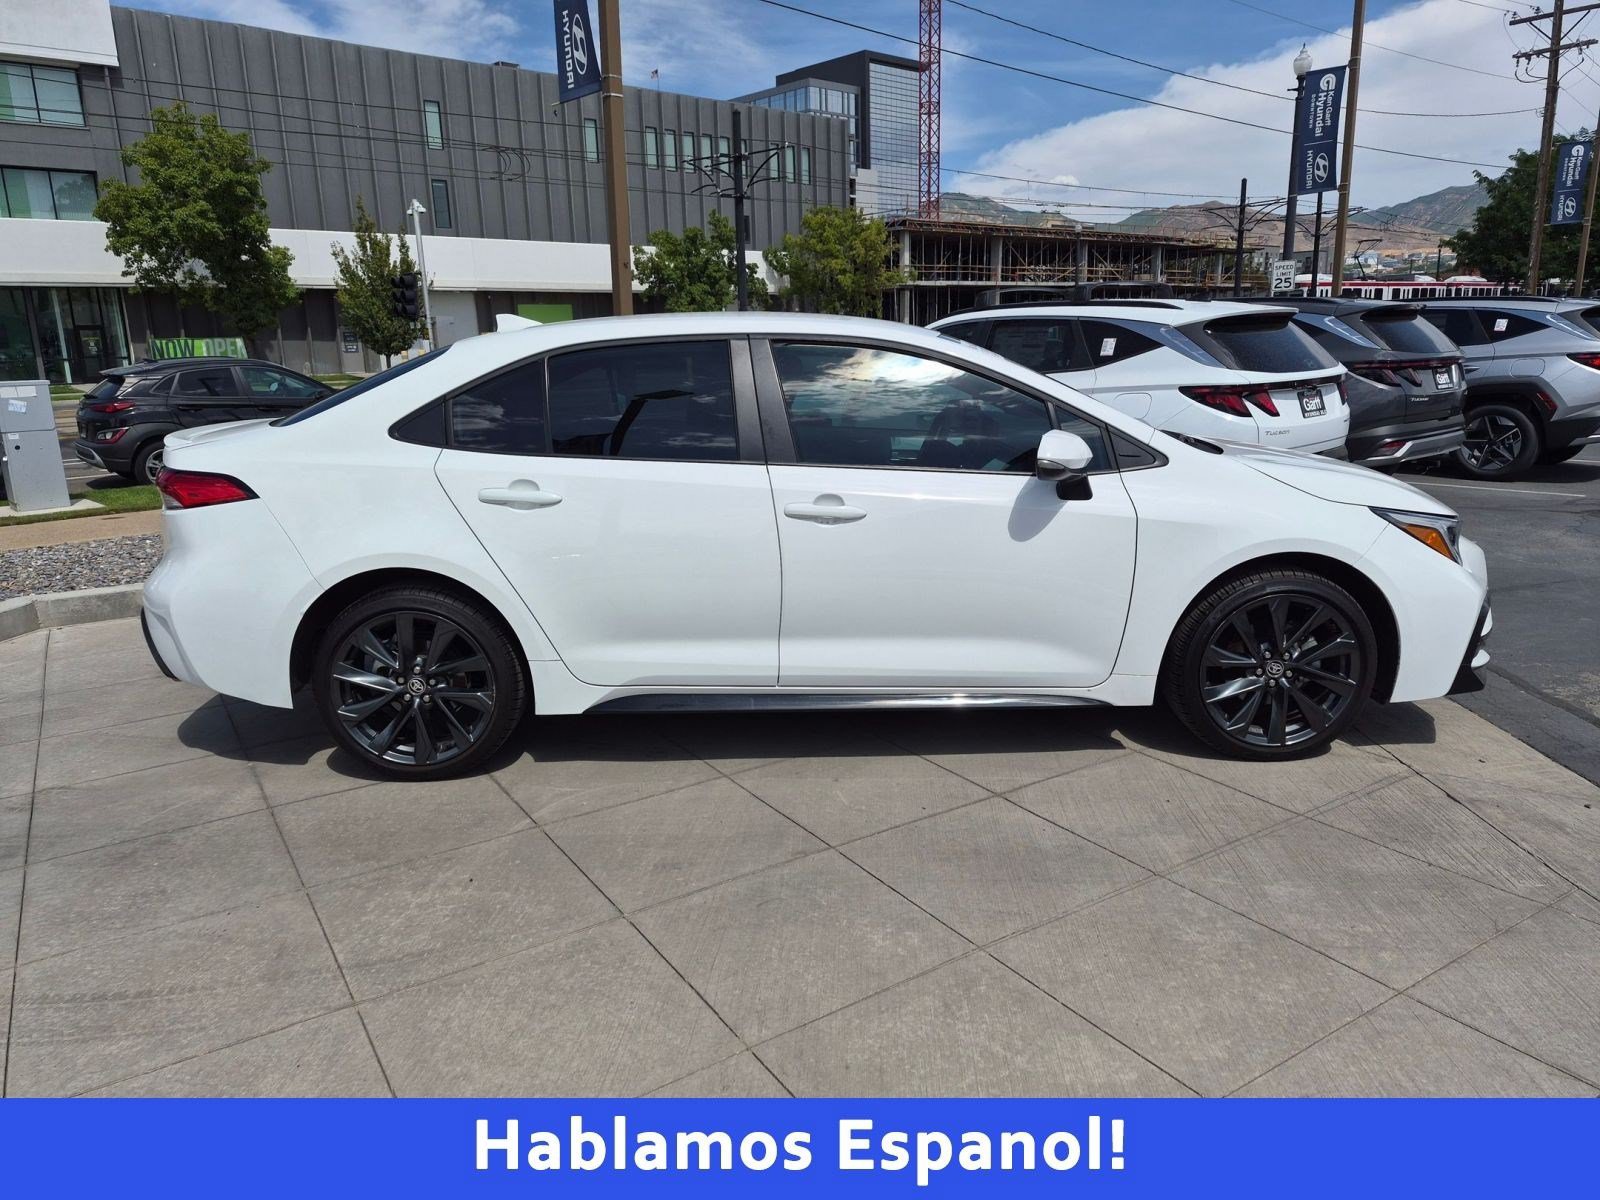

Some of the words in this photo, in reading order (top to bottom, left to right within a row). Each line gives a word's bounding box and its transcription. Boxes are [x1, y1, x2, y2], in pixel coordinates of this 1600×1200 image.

[562, 10, 575, 89] HYUNDAI
[1326, 92, 1334, 106] Ken
[1315, 92, 1326, 136] Hyundai
[1566, 157, 1576, 186] Hyundai
[1274, 278, 1292, 288] 25
[149, 339, 195, 360] NOW
[202, 338, 248, 359] OPEN
[1303, 396, 1322, 411] Garff
